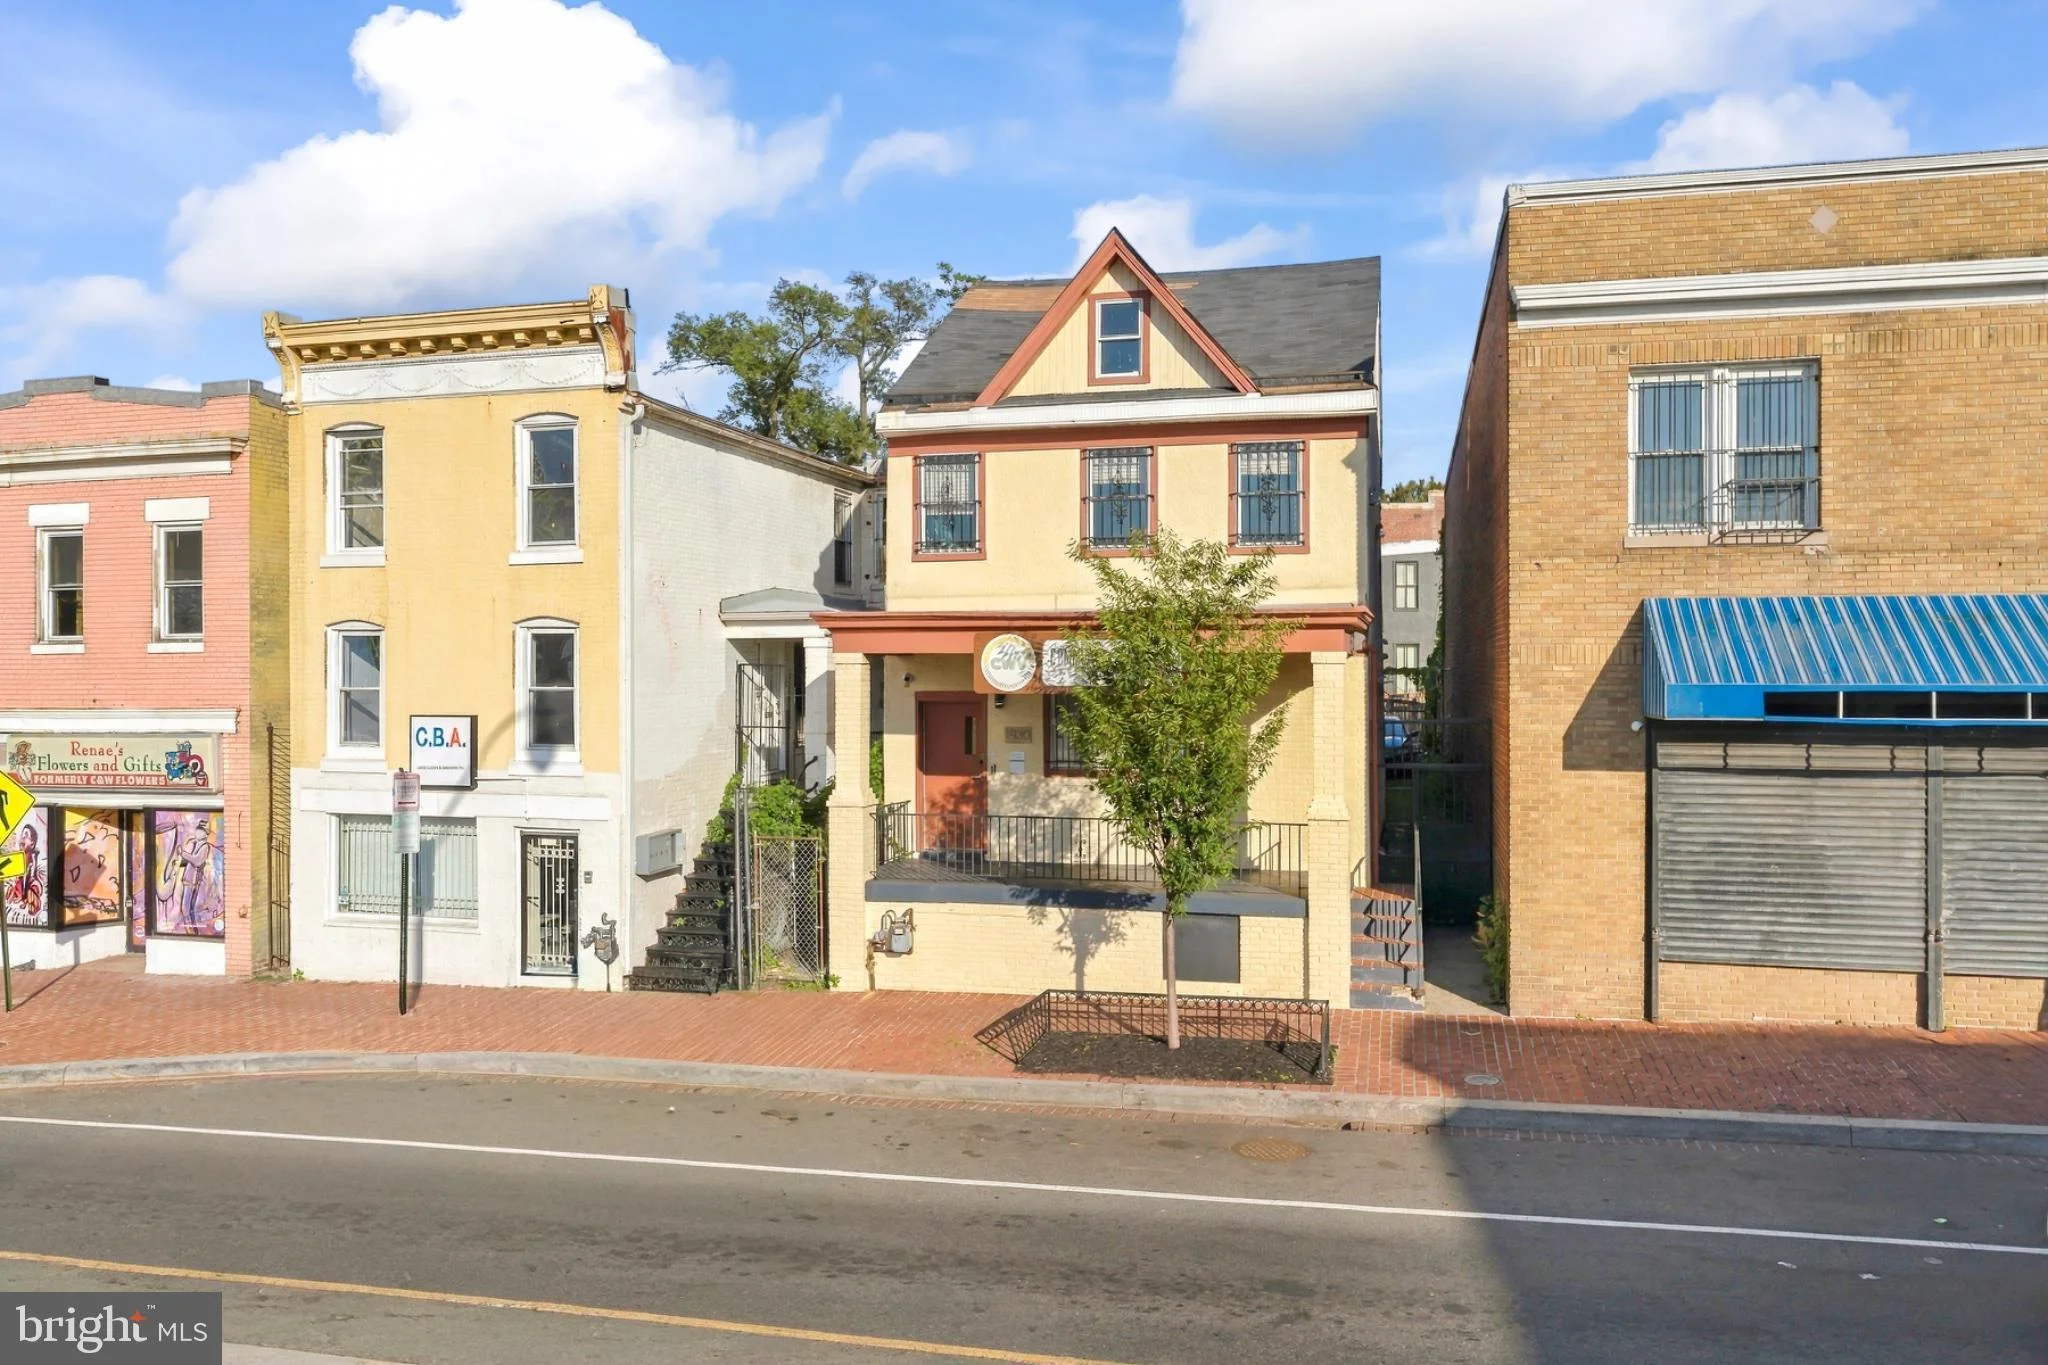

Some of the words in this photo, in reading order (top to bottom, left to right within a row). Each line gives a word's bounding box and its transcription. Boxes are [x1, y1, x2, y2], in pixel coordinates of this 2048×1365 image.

[415, 726, 467, 748] C.B.A.
[70, 741, 124, 757] Renae's
[37, 754, 89, 772] Flowers
[93, 755, 119, 772] and
[124, 756, 162, 772] Gifts
[33, 774, 88, 786] FORMERLY
[116, 775, 166, 787] FLOWERS
